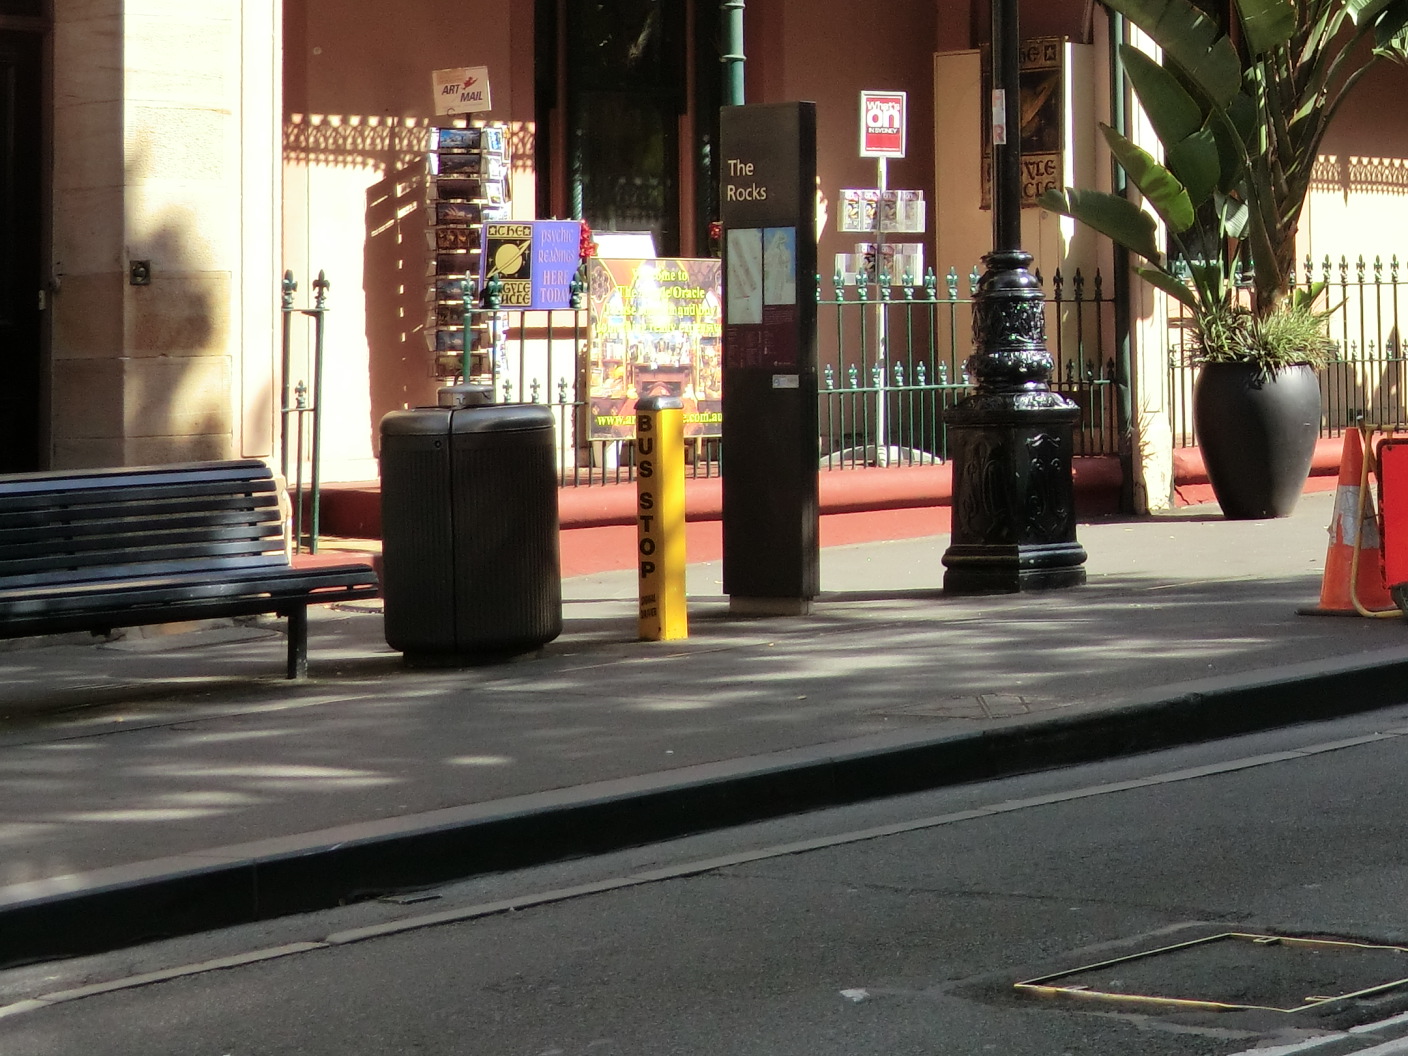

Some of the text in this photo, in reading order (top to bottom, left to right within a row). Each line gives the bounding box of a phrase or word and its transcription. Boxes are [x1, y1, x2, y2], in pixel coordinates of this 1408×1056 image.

[442, 84, 461, 95] ART
[460, 93, 483, 102] MAIL
[866, 101, 900, 111] What's
[866, 110, 900, 128] on
[728, 159, 754, 176] The
[727, 183, 767, 201] Rocks
[543, 271, 569, 285] HERE
[678, 270, 688, 280] to
[673, 286, 705, 299] Oracle
[638, 415, 656, 579] BUS STOP
